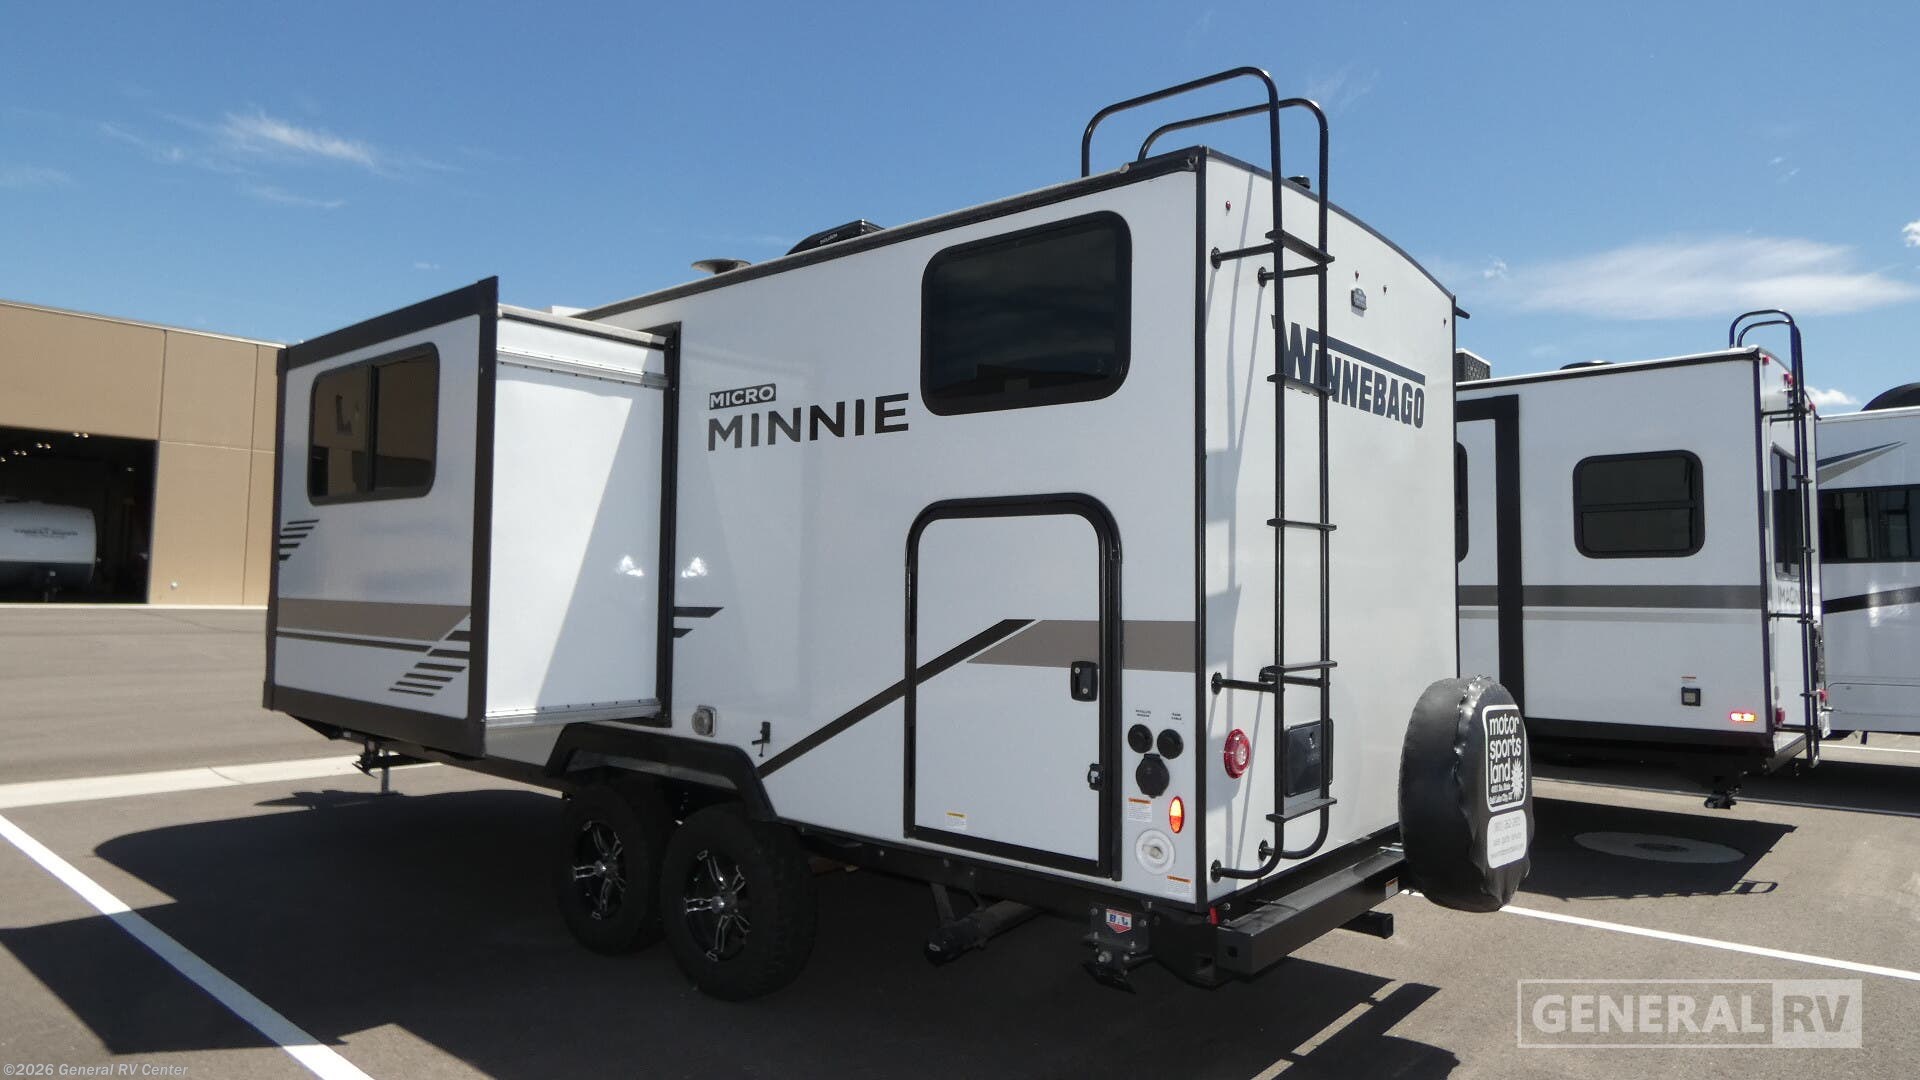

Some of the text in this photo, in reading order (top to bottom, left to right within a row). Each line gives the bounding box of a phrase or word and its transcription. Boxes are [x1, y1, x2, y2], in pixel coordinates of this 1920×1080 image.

[710, 386, 775, 409] MICRO
[708, 392, 909, 452] MINNIE
[1489, 713, 1520, 736] motor
[1489, 734, 1522, 763] sports
[1490, 757, 1511, 785] land
